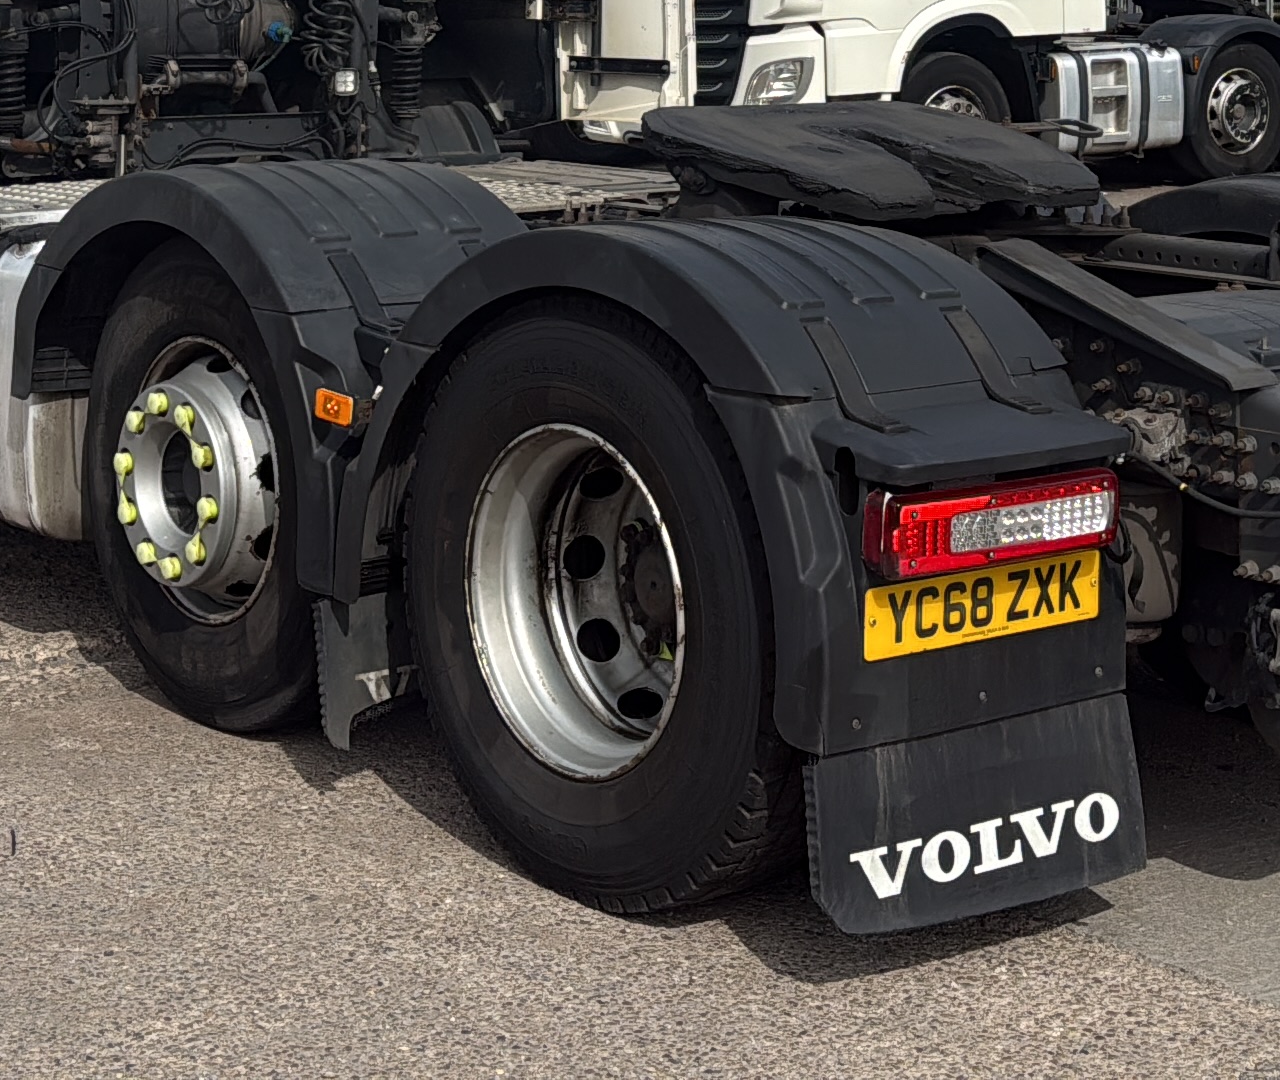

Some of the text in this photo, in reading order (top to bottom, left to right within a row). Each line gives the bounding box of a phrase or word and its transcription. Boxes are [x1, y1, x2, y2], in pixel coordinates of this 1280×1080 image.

[888, 559, 1082, 644] YC68 ZXK
[849, 792, 1119, 899] VOLVO
